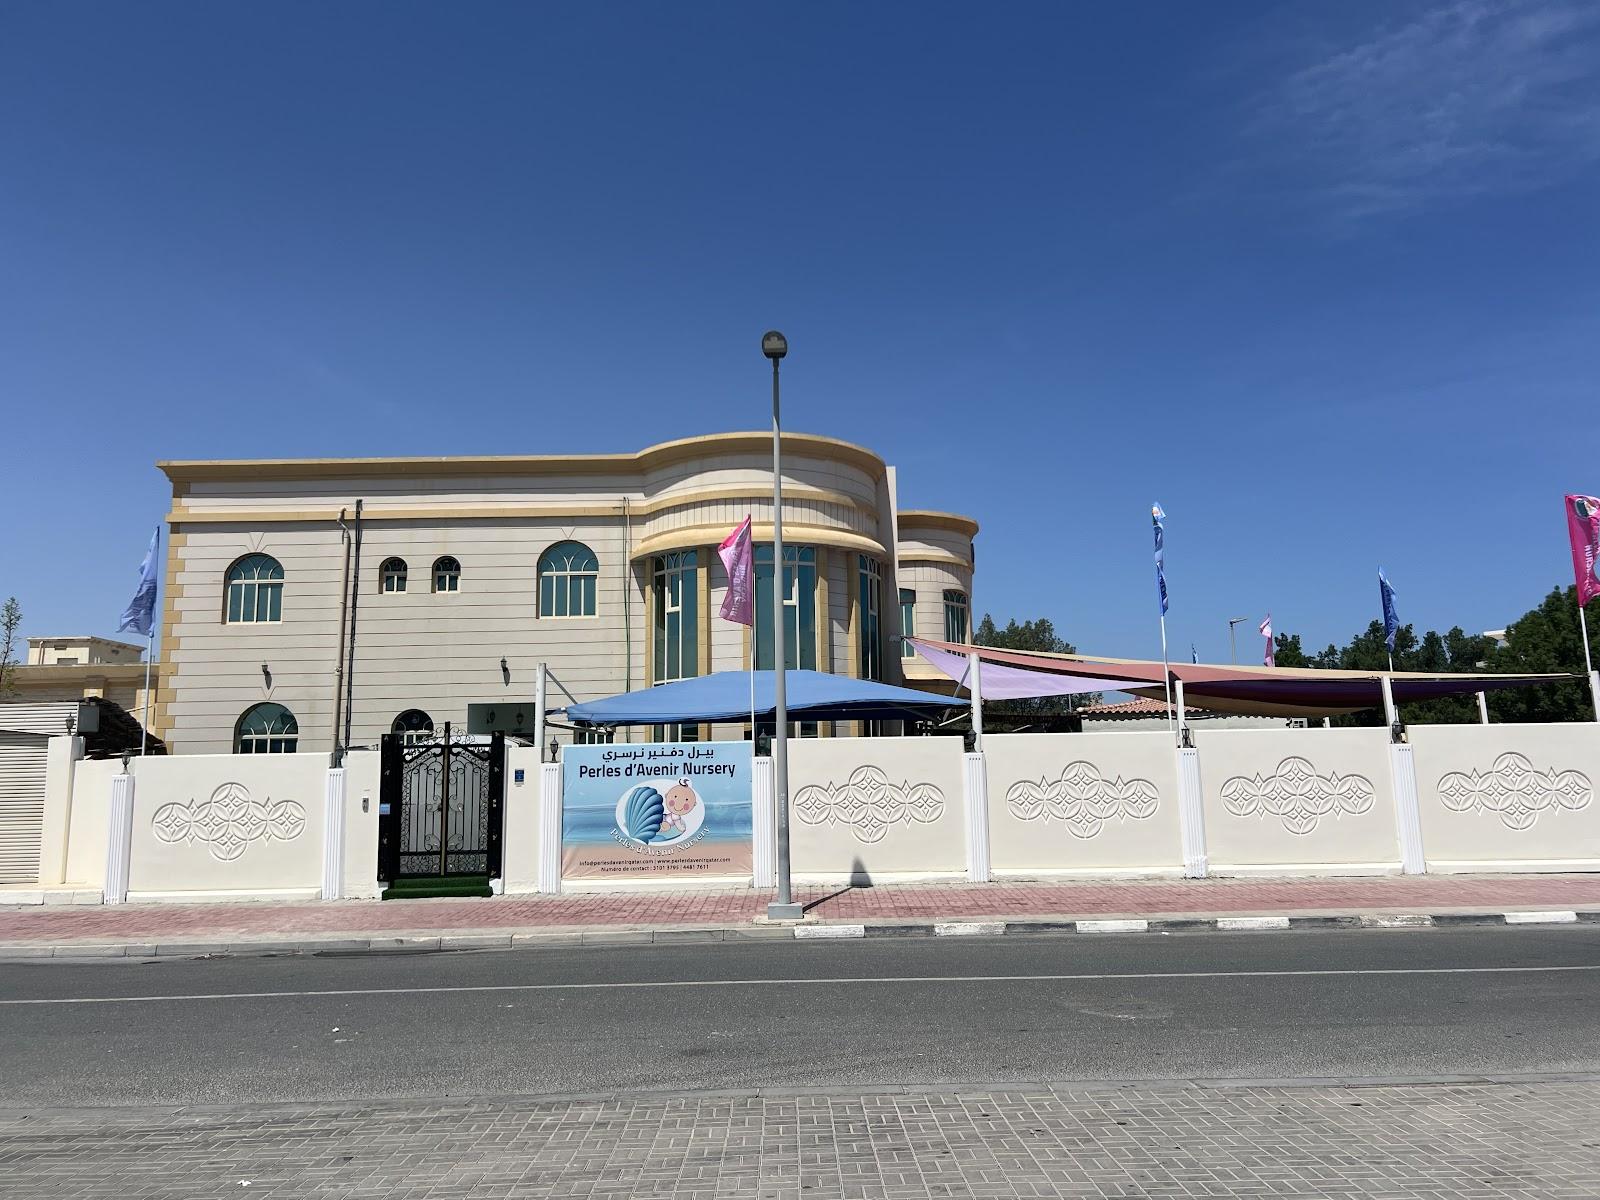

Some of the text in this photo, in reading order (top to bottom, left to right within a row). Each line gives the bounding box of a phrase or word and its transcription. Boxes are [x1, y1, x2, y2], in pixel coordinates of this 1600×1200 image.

[602, 747, 645, 763] نرسري
[579, 763, 621, 778] Perles
[683, 762, 736, 778] Nursery
[610, 828, 635, 850] Perles
[676, 826, 710, 850] Nursery
